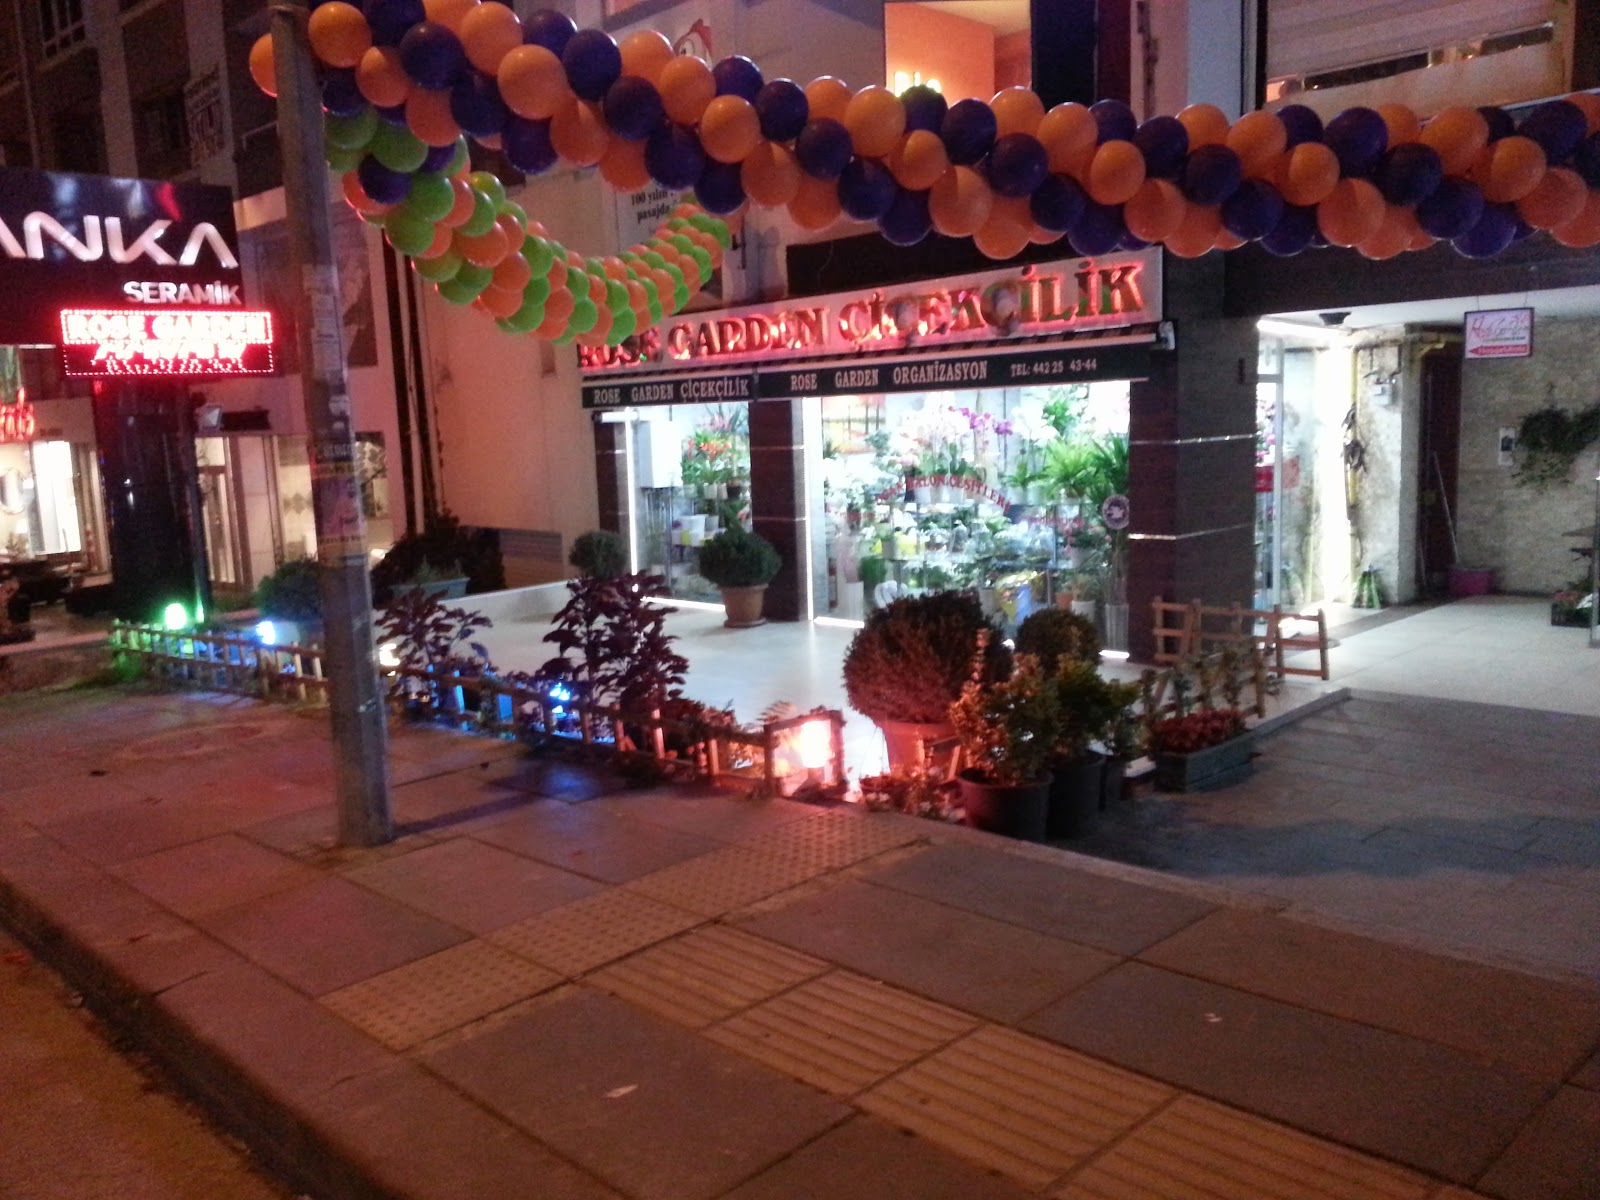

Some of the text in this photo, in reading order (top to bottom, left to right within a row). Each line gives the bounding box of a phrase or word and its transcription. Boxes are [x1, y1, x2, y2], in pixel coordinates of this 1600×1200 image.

[123, 280, 242, 306] SERAMİK
[66, 314, 266, 341] ROSE GARDEN
[667, 305, 832, 361] GARDEN
[791, 373, 818, 391] ROSE
[835, 369, 879, 388] GARDEN
[893, 360, 988, 384] ORGANİZASYON
[1010, 363, 1031, 377] TEL:
[594, 377, 750, 404] ROSE GARDEN ÇİÇEKÇİLİK
